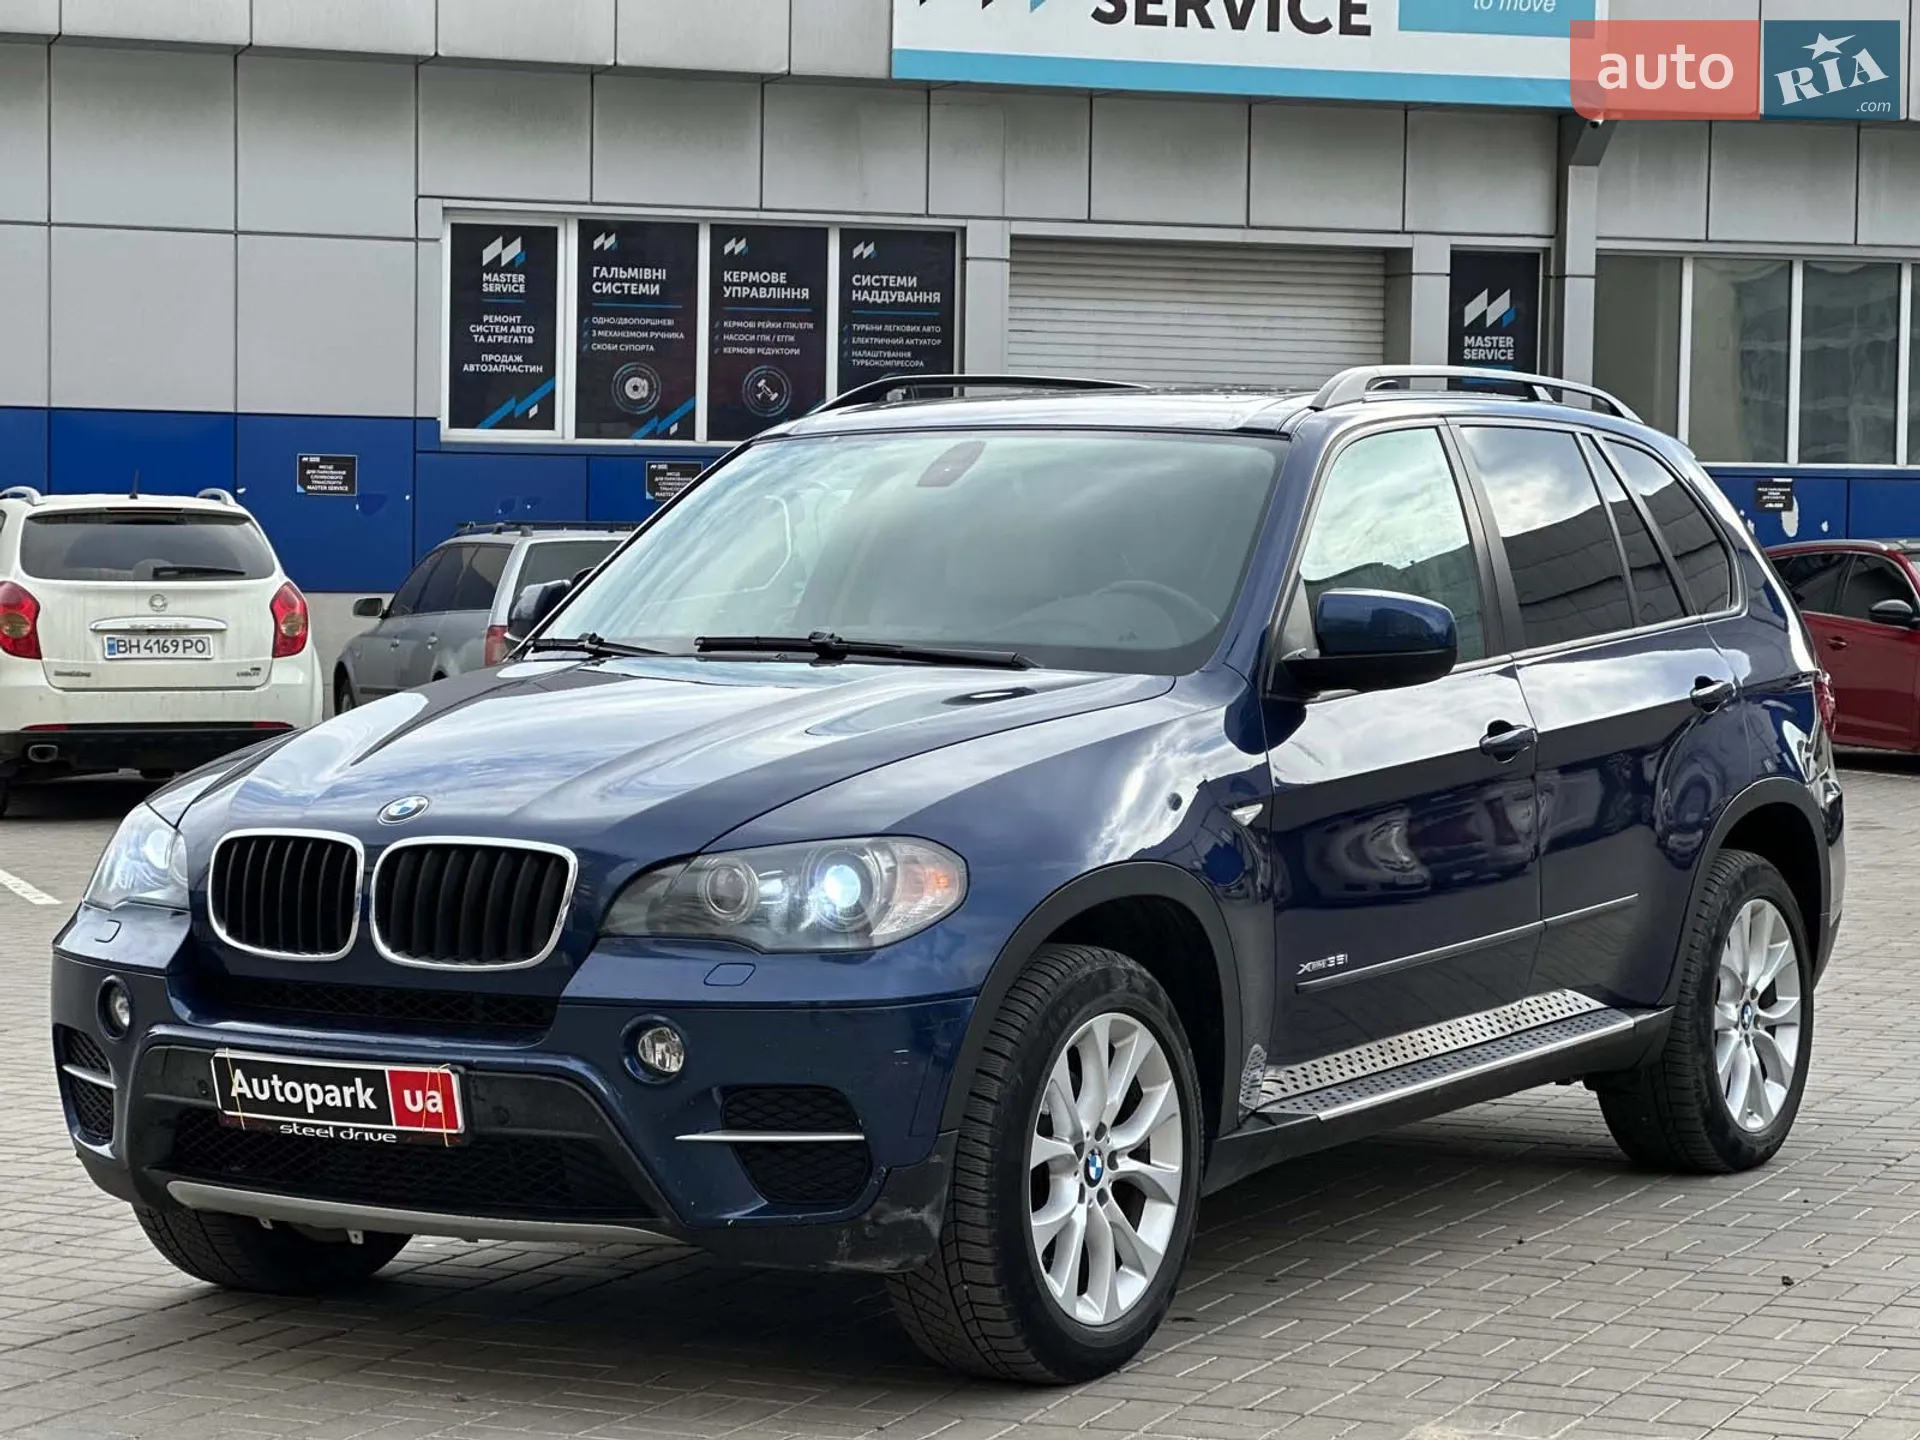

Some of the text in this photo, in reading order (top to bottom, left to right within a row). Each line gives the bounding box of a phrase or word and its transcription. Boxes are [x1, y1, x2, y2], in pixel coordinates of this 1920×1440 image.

[482, 273, 525, 283] MASTER
[592, 266, 667, 280] ГАЛЬМІВНІ
[723, 271, 787, 283] КЕРМОВЕ
[852, 274, 917, 287] СИСТЕМИ
[482, 283, 526, 293] SERVICE
[592, 282, 660, 295] СИСТЕМИ
[723, 286, 809, 299] УПРАВЛІННЯ
[852, 289, 941, 304] НАДДУВАННЯ
[483, 315, 522, 323] РЕМОНТ
[469, 324, 535, 334] СИСТЕМ АВТО
[473, 334, 534, 344] ТА АГРЕГАТІВ
[1464, 336, 1514, 348] MASTER
[481, 354, 523, 363] ПРОДАЖ
[1463, 348, 1515, 360] SERVICE
[463, 364, 543, 373] АВТОЗАПЧАСТИН
[117, 639, 206, 654] BH 4169 PO
[231, 1069, 377, 1114] Autopark
[403, 1090, 444, 1113] ua
[280, 1122, 397, 1143] steel drive
